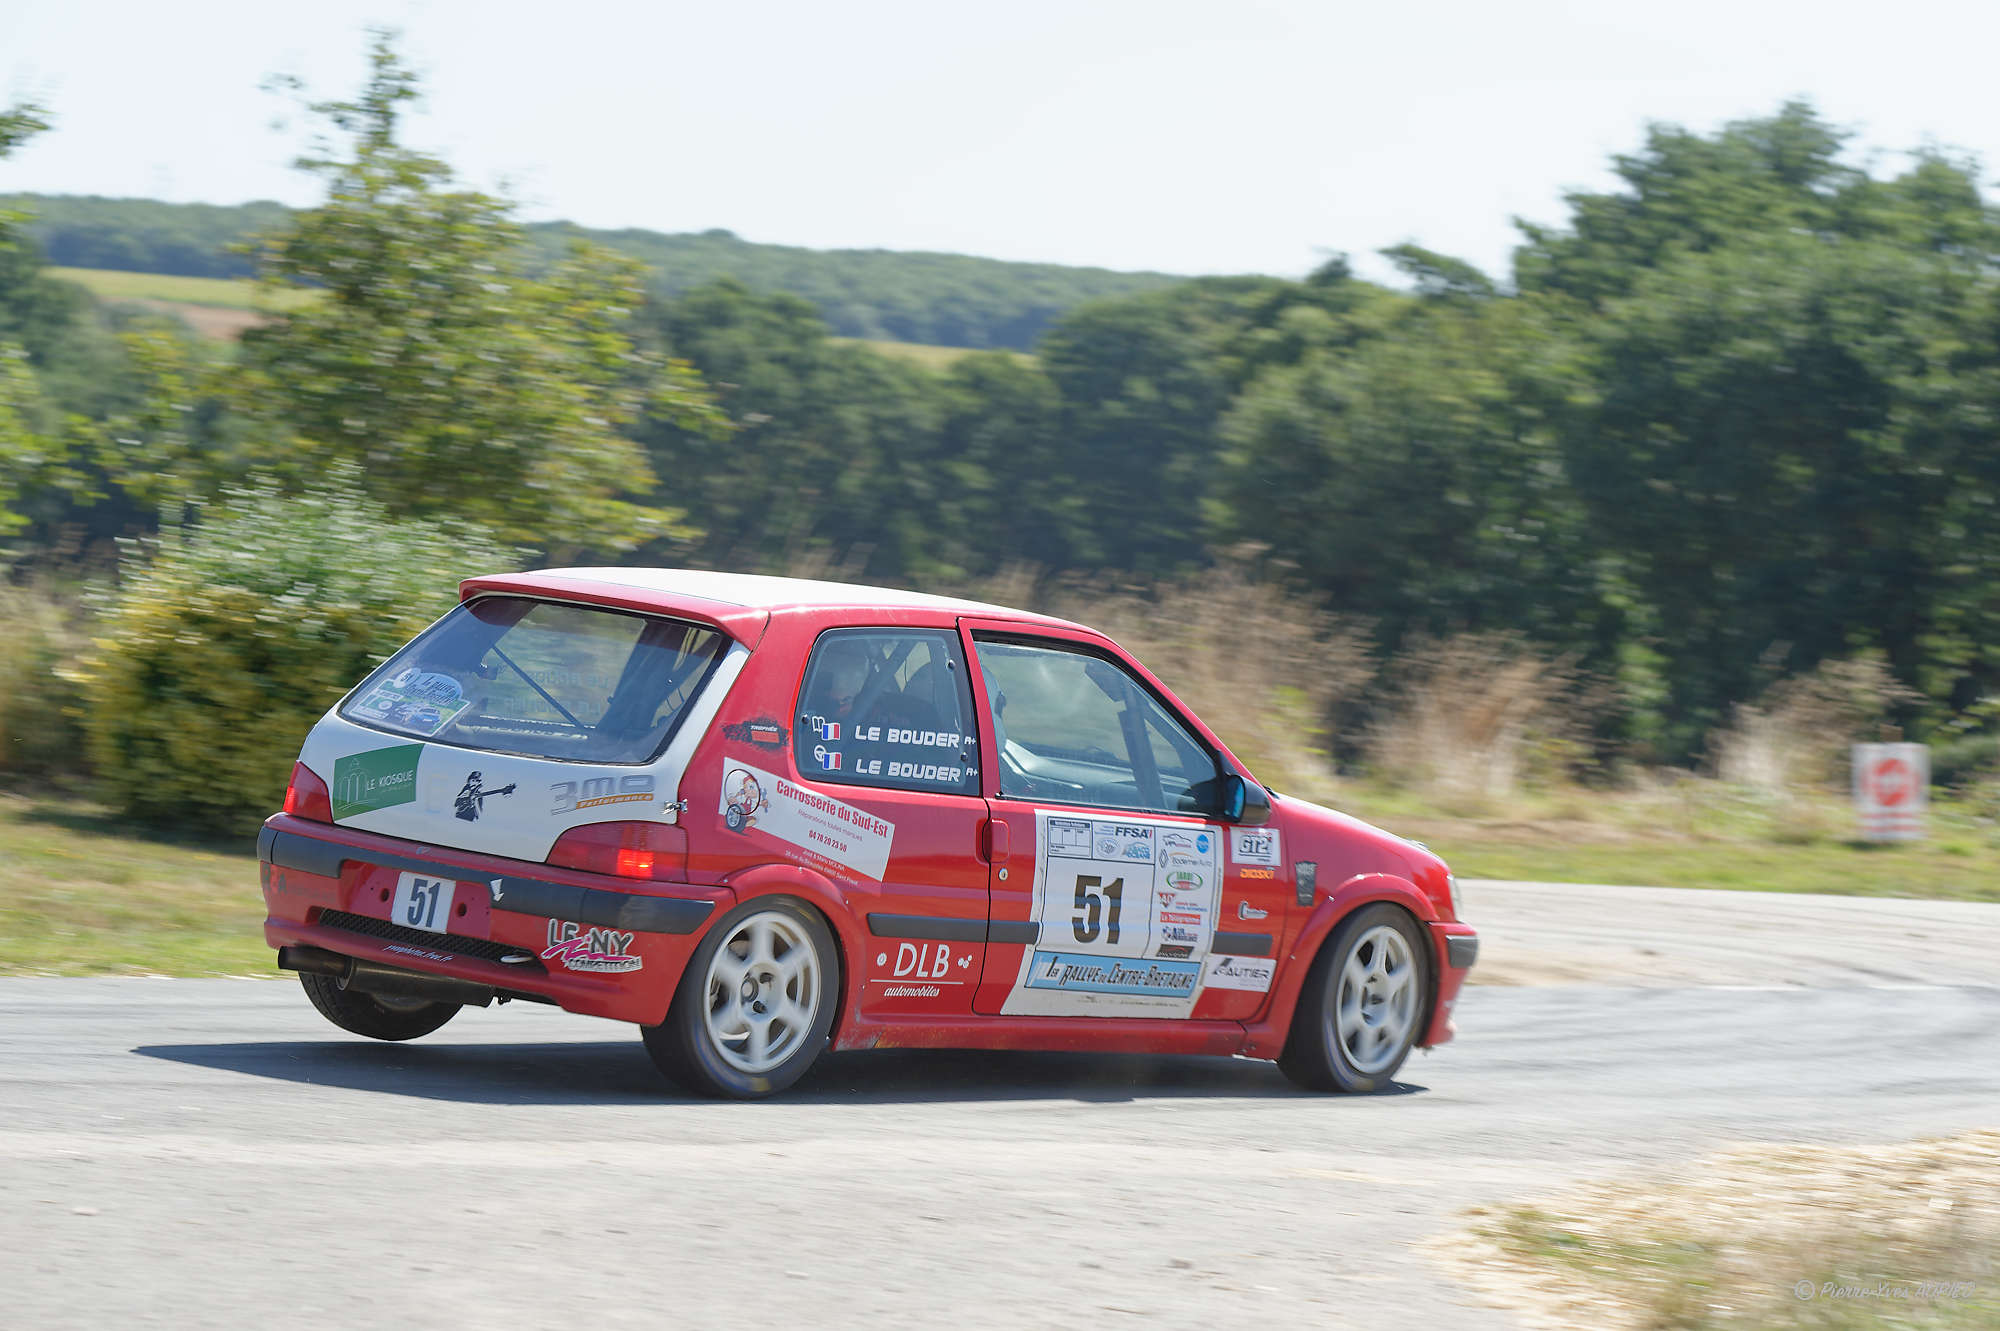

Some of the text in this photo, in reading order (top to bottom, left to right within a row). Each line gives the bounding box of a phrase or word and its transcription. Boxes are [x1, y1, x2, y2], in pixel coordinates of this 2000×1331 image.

[855, 725, 881, 741] LE
[887, 728, 960, 748] BOUDER
[366, 779, 376, 791] LE
[379, 769, 414, 787] KIOSQUE
[855, 759, 882, 775] LE
[887, 761, 961, 782] BOUDER
[776, 780, 888, 838] Carrosserie du Sud-Est
[1115, 826, 1149, 839] FFSA
[407, 878, 441, 929] 51
[1071, 874, 1124, 945] 51
[589, 927, 635, 957] NY
[893, 942, 950, 978] DLB
[1059, 965, 1102, 986] RALLYE
[884, 985, 940, 997] automobiles
